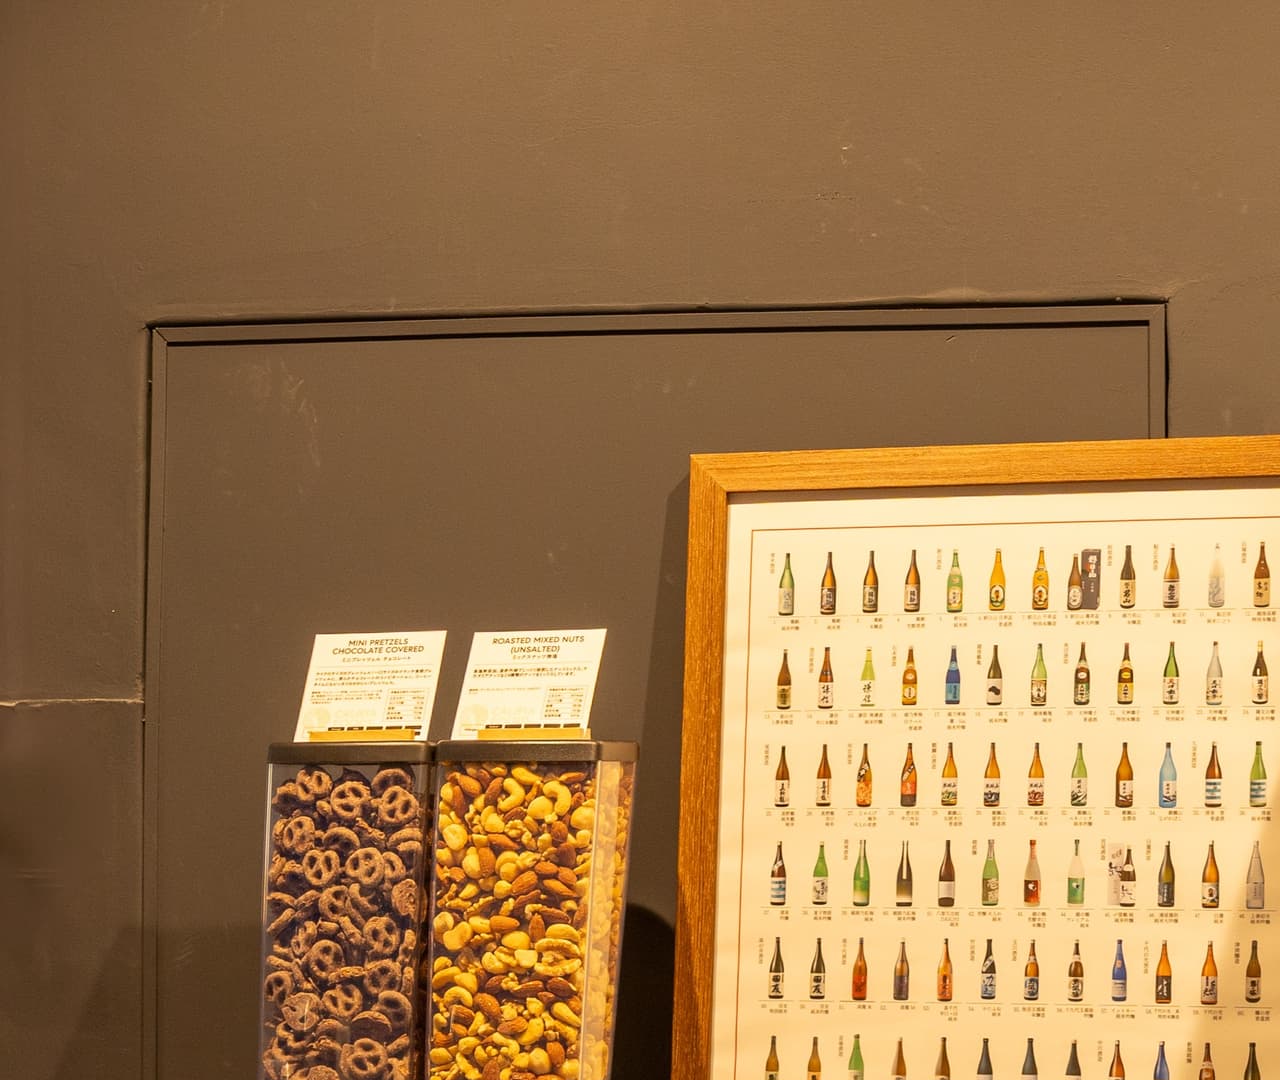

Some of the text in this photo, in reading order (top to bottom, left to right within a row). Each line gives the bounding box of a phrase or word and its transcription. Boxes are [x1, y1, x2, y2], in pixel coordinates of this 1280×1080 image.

[369, 638, 409, 646] PRETZELS
[492, 635, 585, 645] ROASTED MIXED NUTS
[332, 645, 425, 655] CHOCOLATE COVERED
[510, 645, 561, 655] (UNSALTED)
